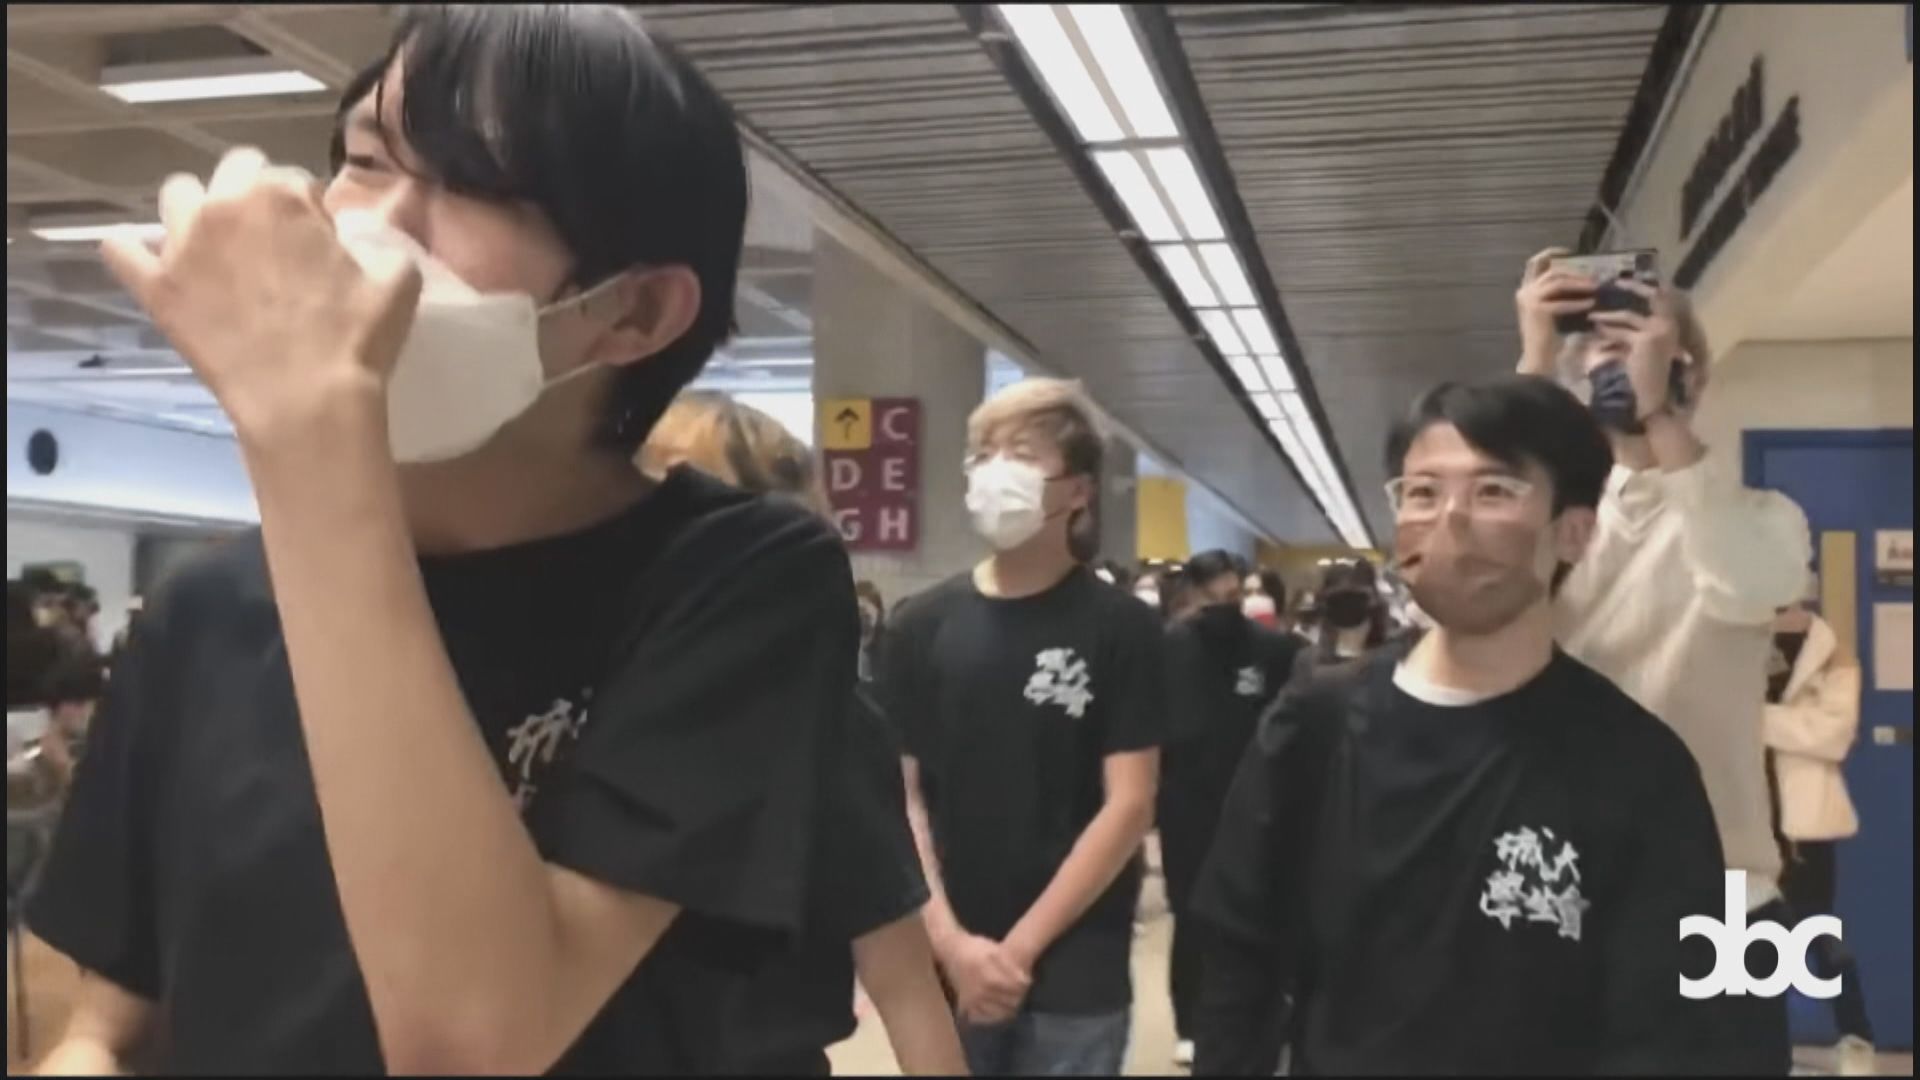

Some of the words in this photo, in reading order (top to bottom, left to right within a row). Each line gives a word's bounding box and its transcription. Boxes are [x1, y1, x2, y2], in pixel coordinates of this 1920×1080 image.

[882, 407, 909, 441] C
[831, 457, 862, 492] D
[883, 457, 905, 491] E
[834, 507, 862, 541] G
[879, 506, 909, 541] H
